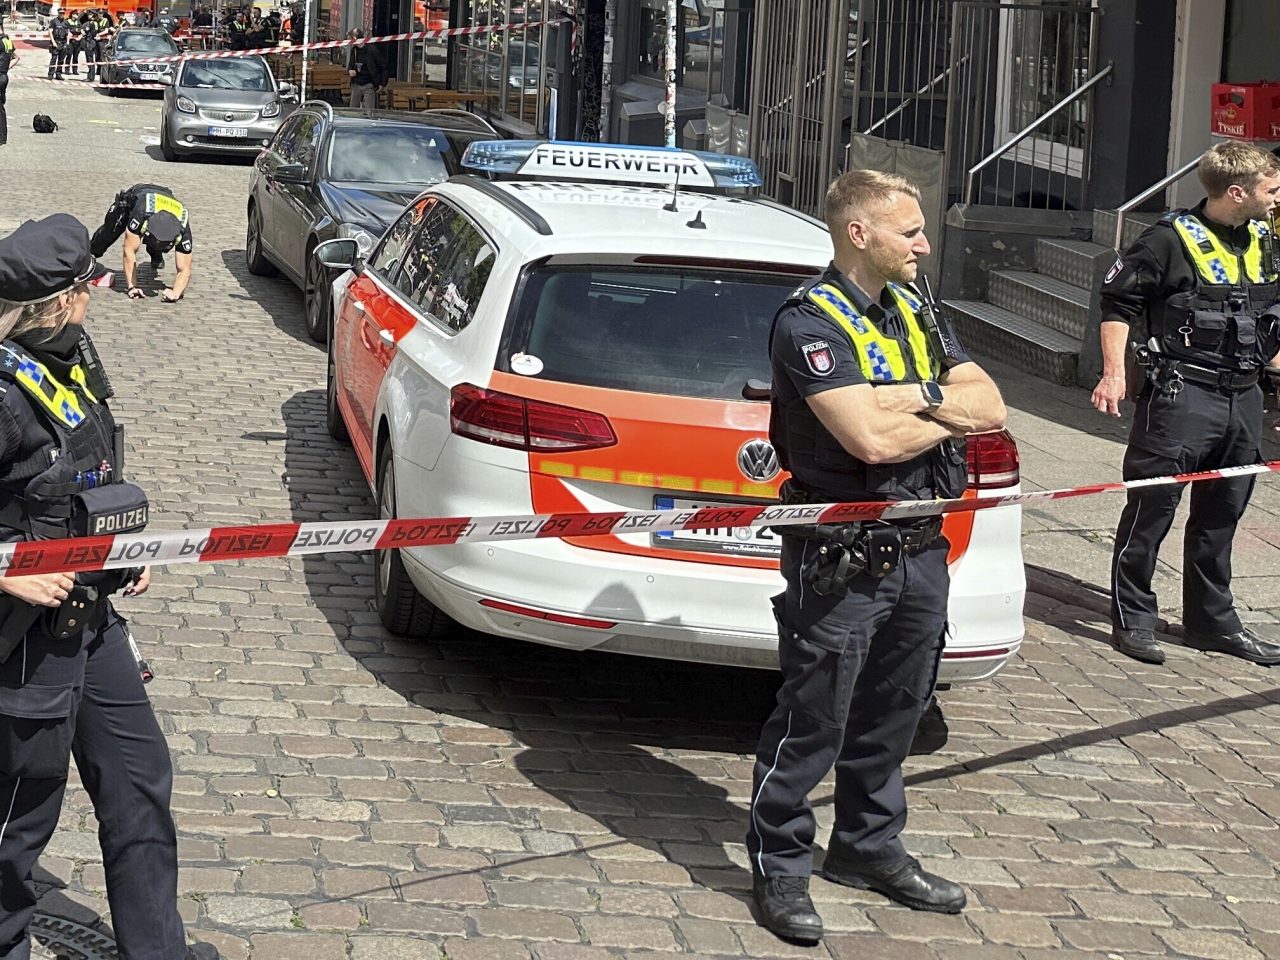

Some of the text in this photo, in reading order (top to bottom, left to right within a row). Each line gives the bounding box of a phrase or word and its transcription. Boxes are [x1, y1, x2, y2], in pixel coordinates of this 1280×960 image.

[1217, 121, 1245, 136] TYSKIE
[536, 148, 699, 175] FEUERWEHR
[95, 507, 147, 533] POLIZEI
